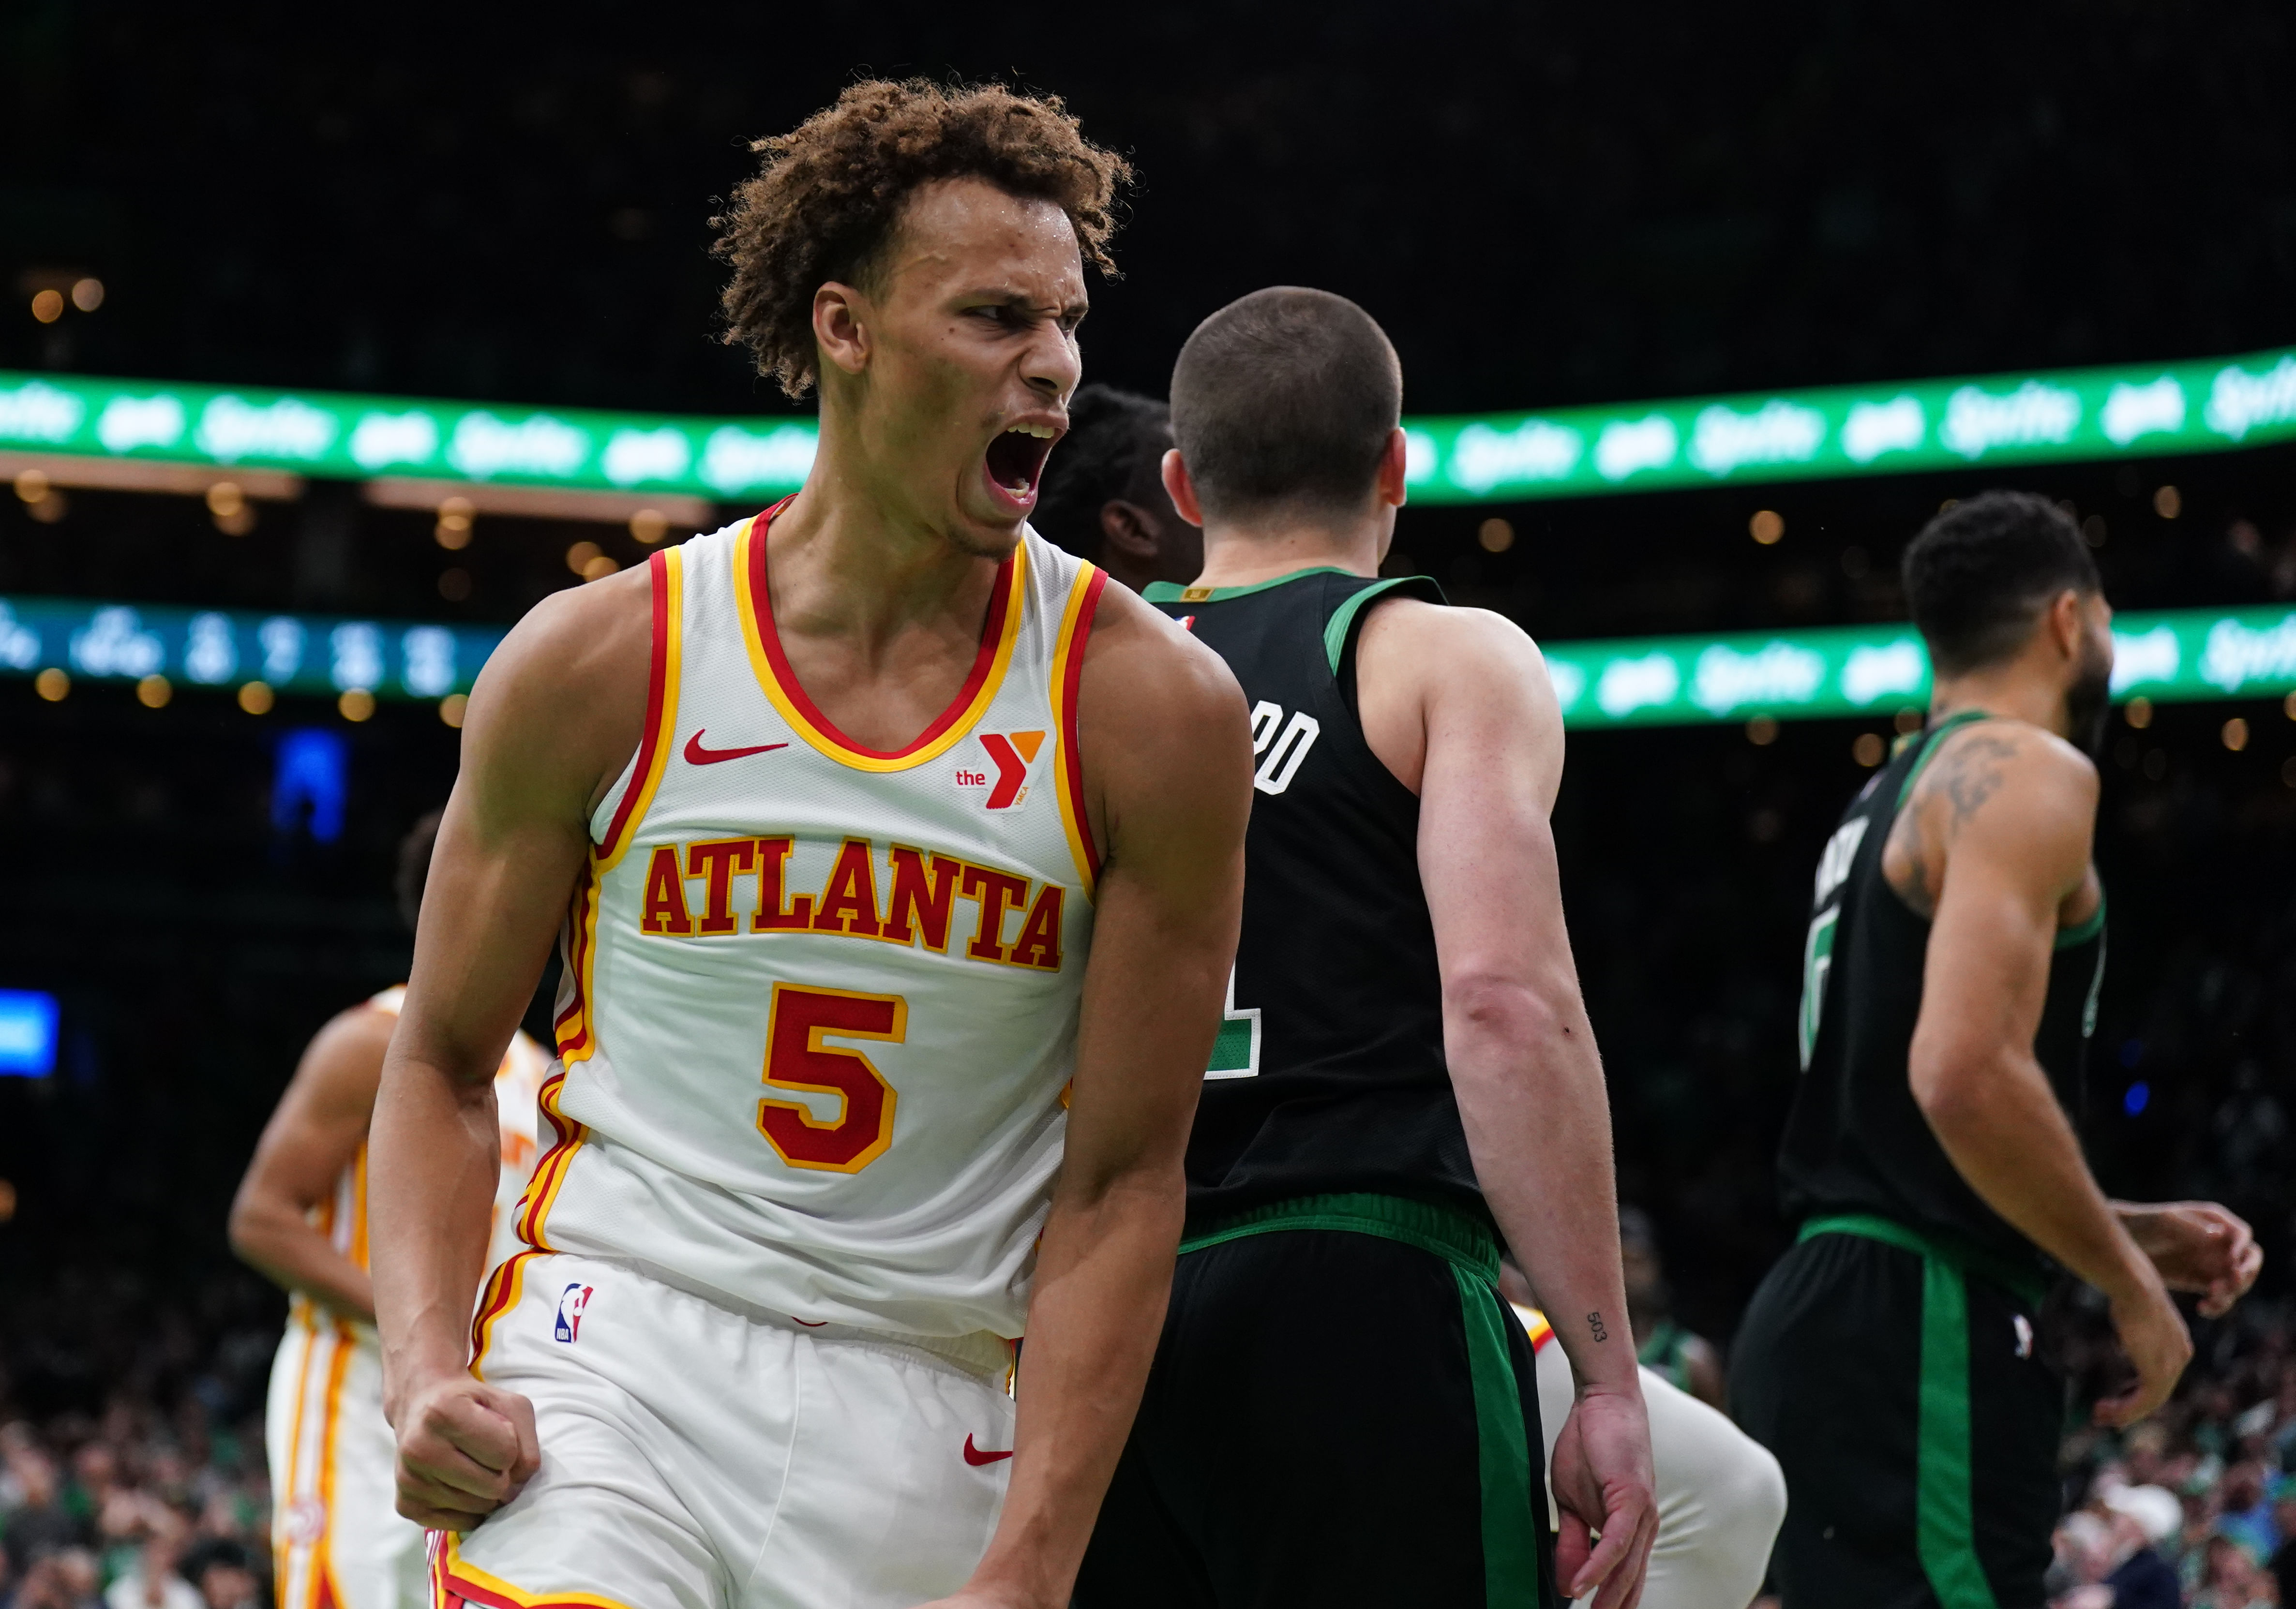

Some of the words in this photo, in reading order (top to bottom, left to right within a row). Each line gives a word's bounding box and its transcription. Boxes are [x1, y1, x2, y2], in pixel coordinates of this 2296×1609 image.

[956, 770, 985, 785] the
[1015, 787, 1029, 806] YMCA
[640, 834, 1064, 973] ATLANTA
[756, 981, 908, 1174] 5
[556, 1327, 569, 1341] NBA
[1588, 1312, 1607, 1342] 503
